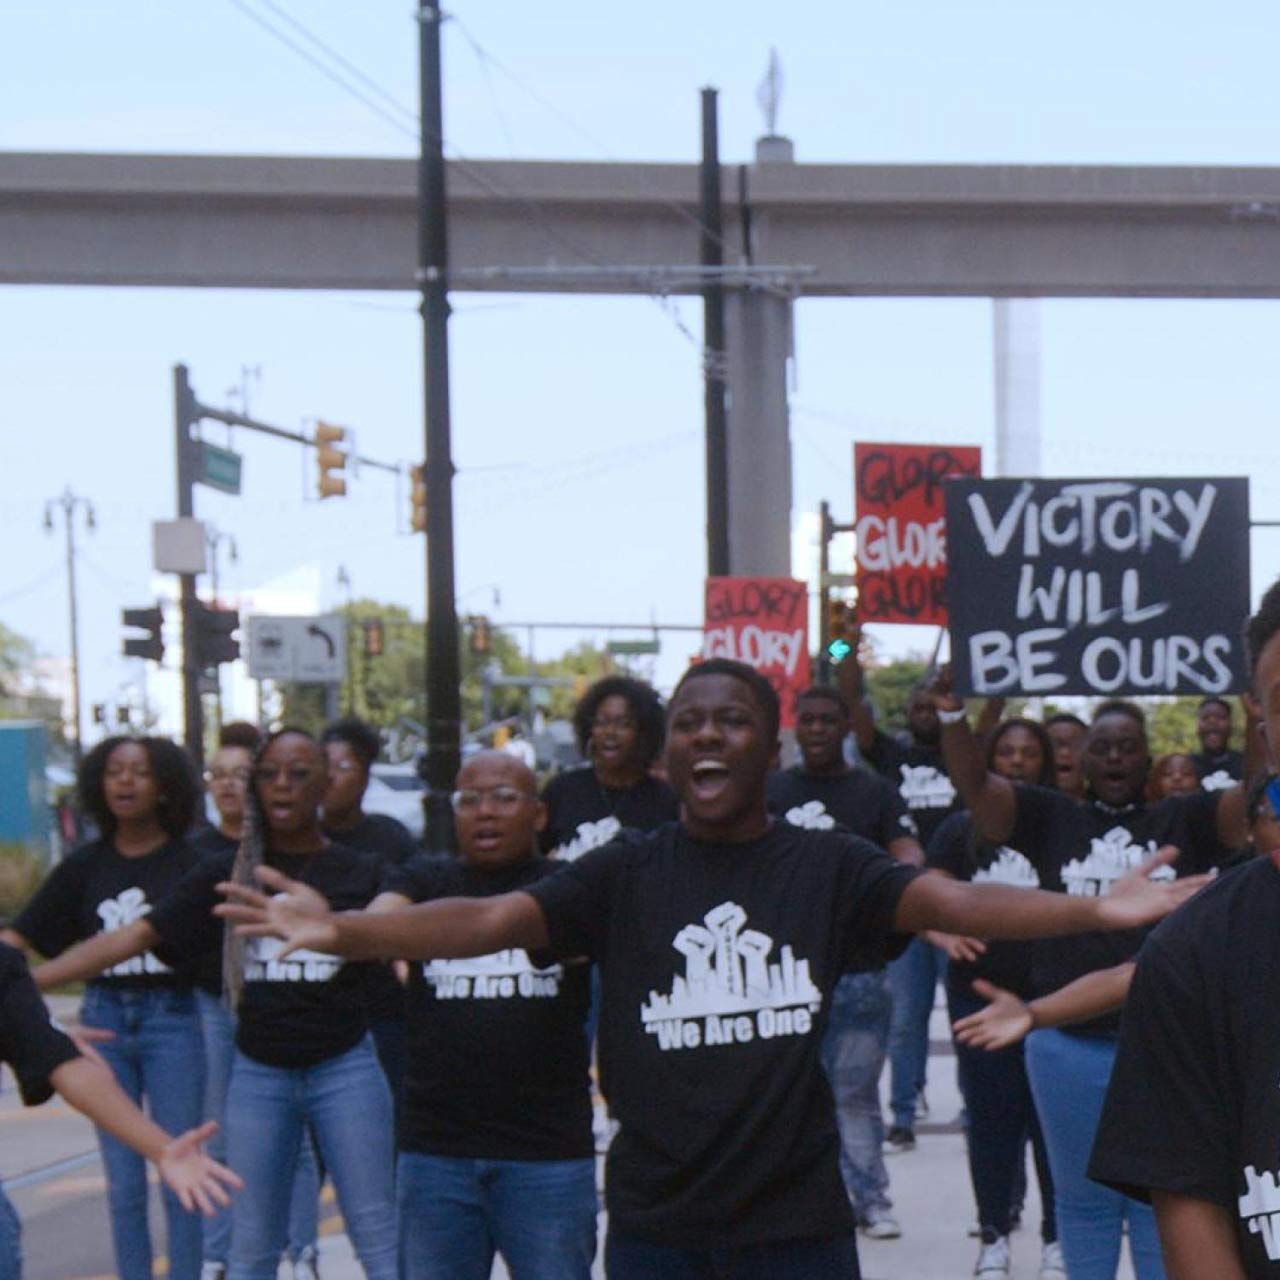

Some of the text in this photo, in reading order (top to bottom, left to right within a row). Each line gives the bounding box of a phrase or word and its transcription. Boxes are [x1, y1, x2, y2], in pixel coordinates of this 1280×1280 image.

[860, 452, 978, 508] GLOR
[856, 515, 947, 571] GLOR
[968, 481, 1216, 562] VICTORY
[707, 583, 800, 627] GLORY
[1016, 564, 1170, 628] WILL
[703, 624, 803, 677] GLORY
[969, 627, 1232, 694] BE OURS
[473, 974, 515, 999] Are
[704, 1014, 753, 1046] Are
